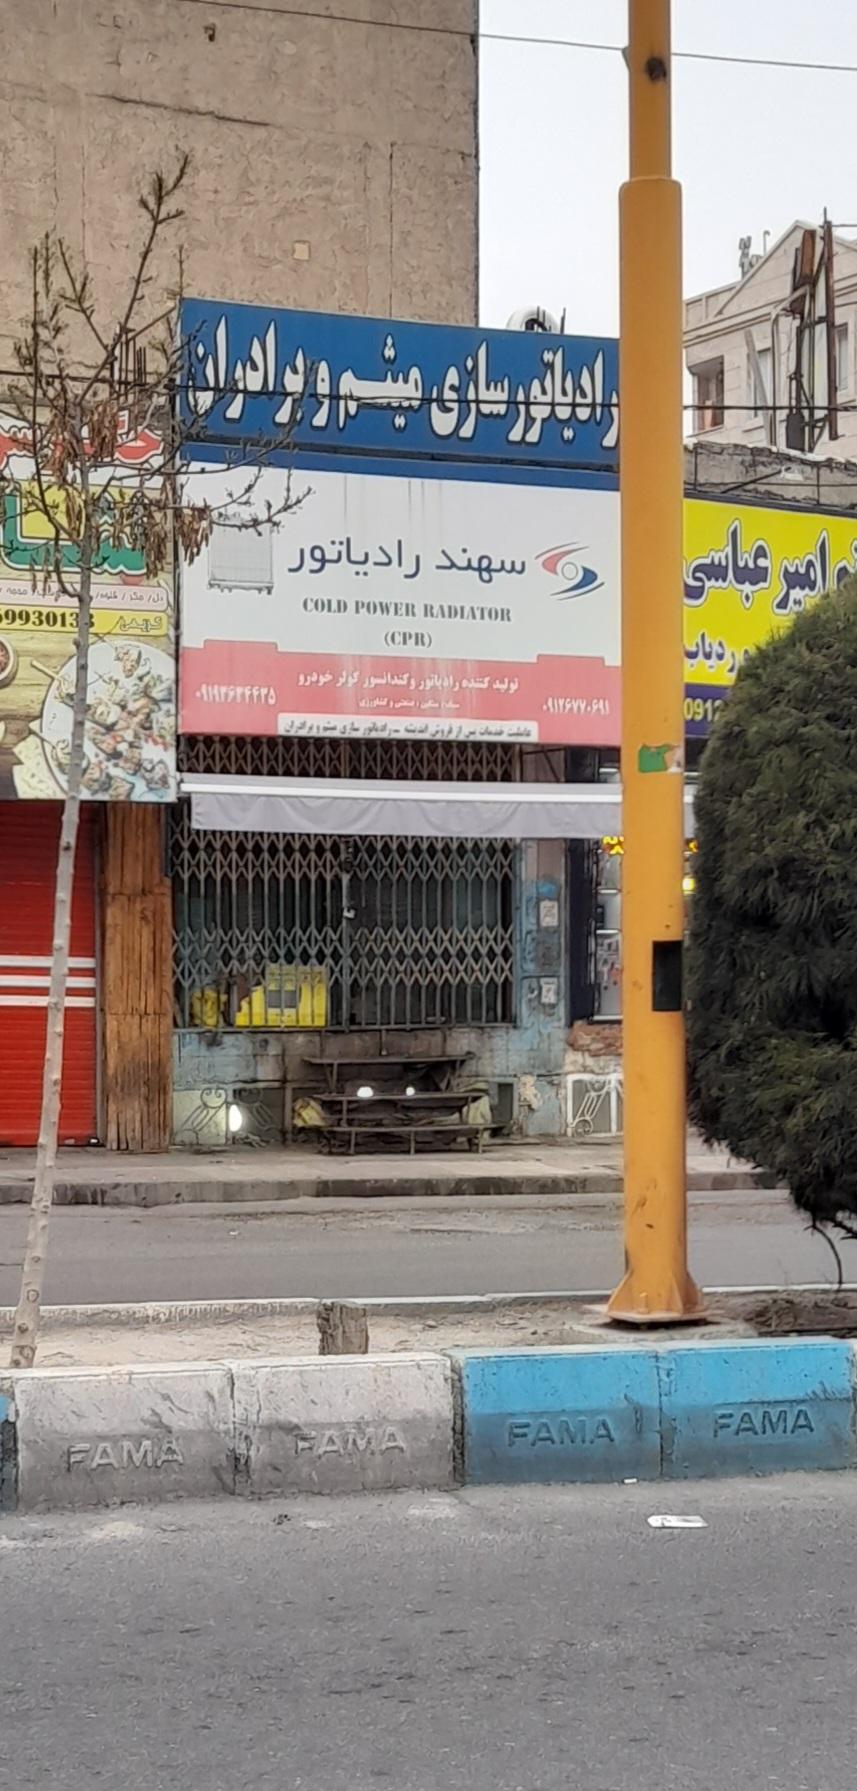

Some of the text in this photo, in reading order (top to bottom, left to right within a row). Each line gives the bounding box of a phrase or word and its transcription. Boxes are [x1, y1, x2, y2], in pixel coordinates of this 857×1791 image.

[187, 314, 305, 425] برادران
[339, 333, 423, 432] میثم
[311, 358, 331, 429] و
[288, 536, 526, 584] سهند رادیاتور
[684, 519, 771, 607] عباسی
[774, 530, 829, 614] امیر
[302, 597, 512, 622] COLD POWER RADIATOR
[384, 631, 432, 648] (CPR)
[297, 669, 334, 687] خودرو
[336, 670, 360, 688] کولر
[418, 674, 460, 692] رادیاتور
[461, 675, 491, 689] کننده
[492, 676, 519, 694] تولید
[506, 1416, 617, 1448] FAMA
[711, 1406, 817, 1440] FAMA
[66, 1440, 185, 1472] FAMA
[293, 1425, 406, 1457] FAMA
